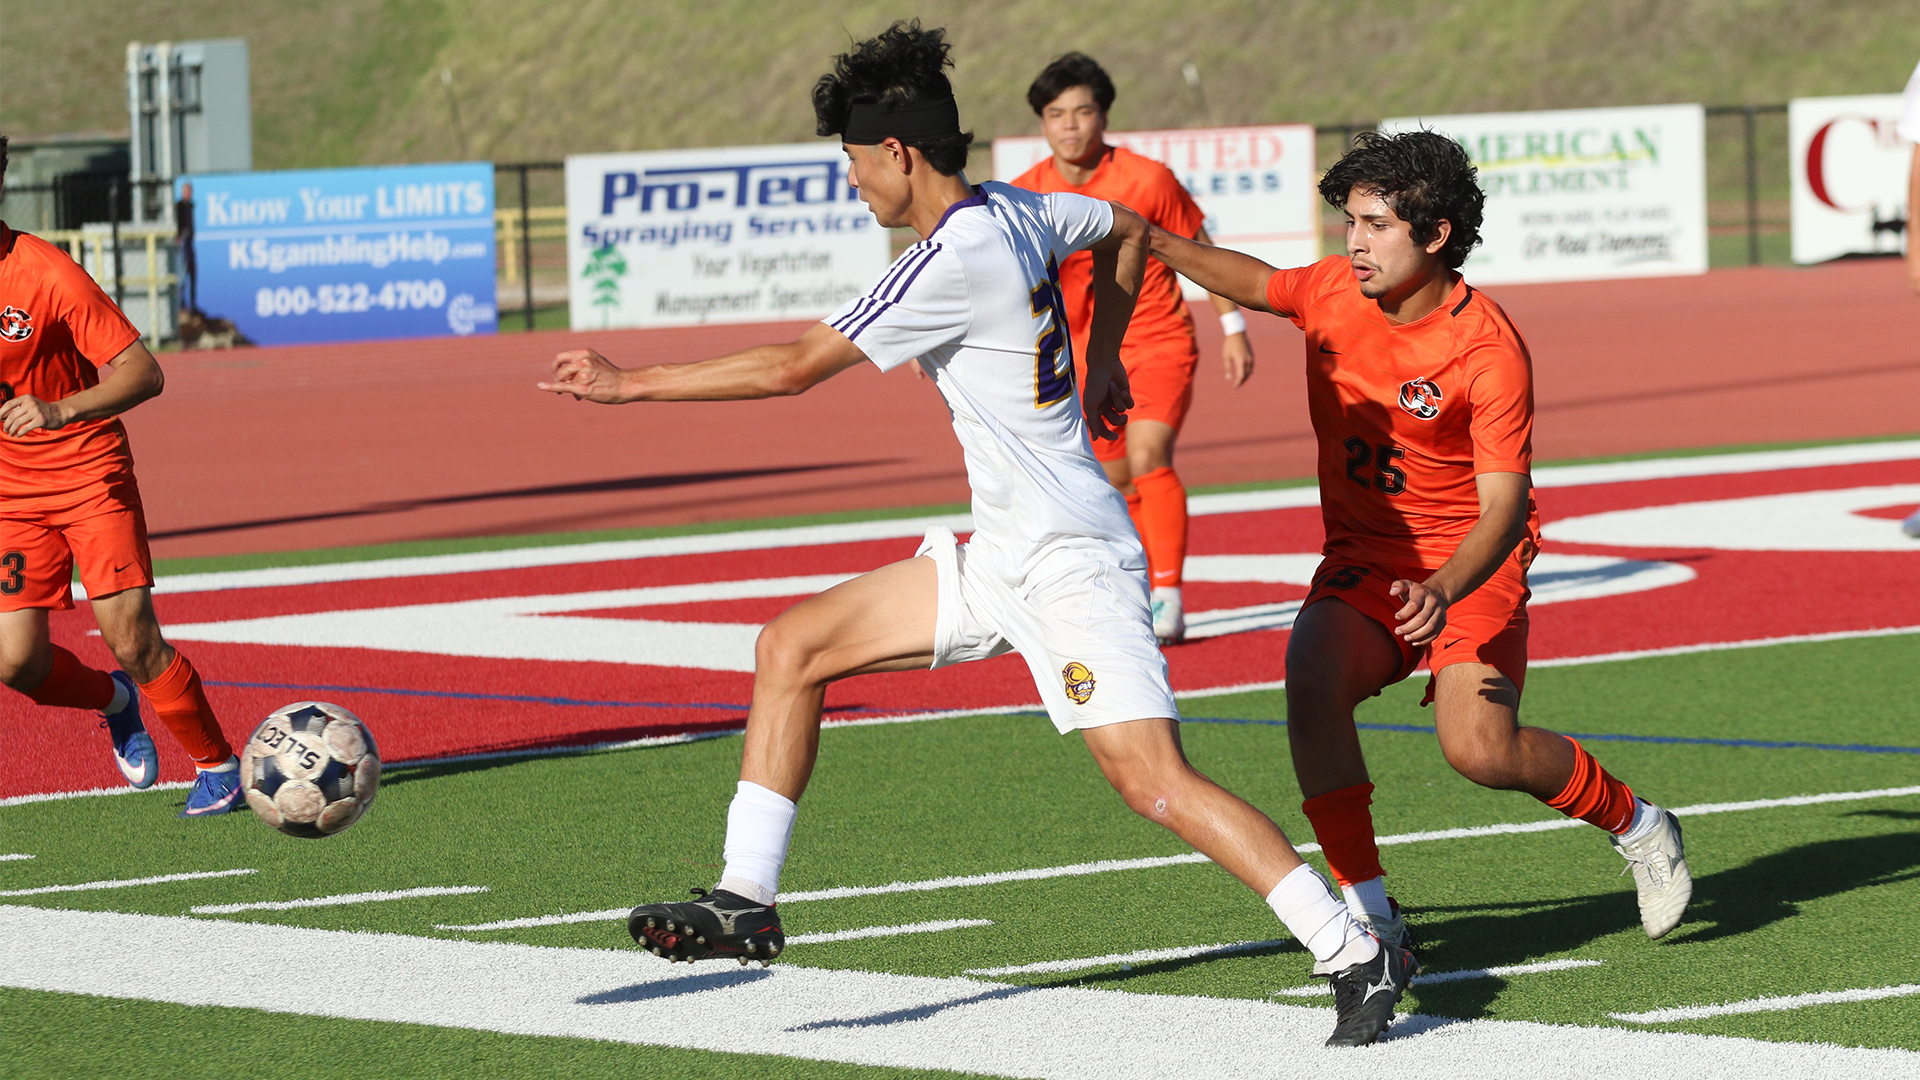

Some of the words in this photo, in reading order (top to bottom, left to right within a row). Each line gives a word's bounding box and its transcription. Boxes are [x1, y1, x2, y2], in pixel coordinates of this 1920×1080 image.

[1457, 125, 1662, 166] MERICAN
[602, 160, 861, 216] Pro-Tech
[1186, 170, 1282, 195] LESS
[1480, 169, 1632, 194] PLEMENT
[206, 191, 289, 226] Know
[297, 187, 369, 222] Your
[375, 181, 487, 219] LIMITS
[582, 219, 733, 250] Spraying
[748, 209, 872, 237] Service
[229, 231, 487, 274] KSgamblingHelp.com
[255, 278, 447, 317] 800-522-4700
[1030, 249, 1077, 410] 2
[1343, 434, 1408, 497] 25
[256, 723, 321, 770] SELECT
